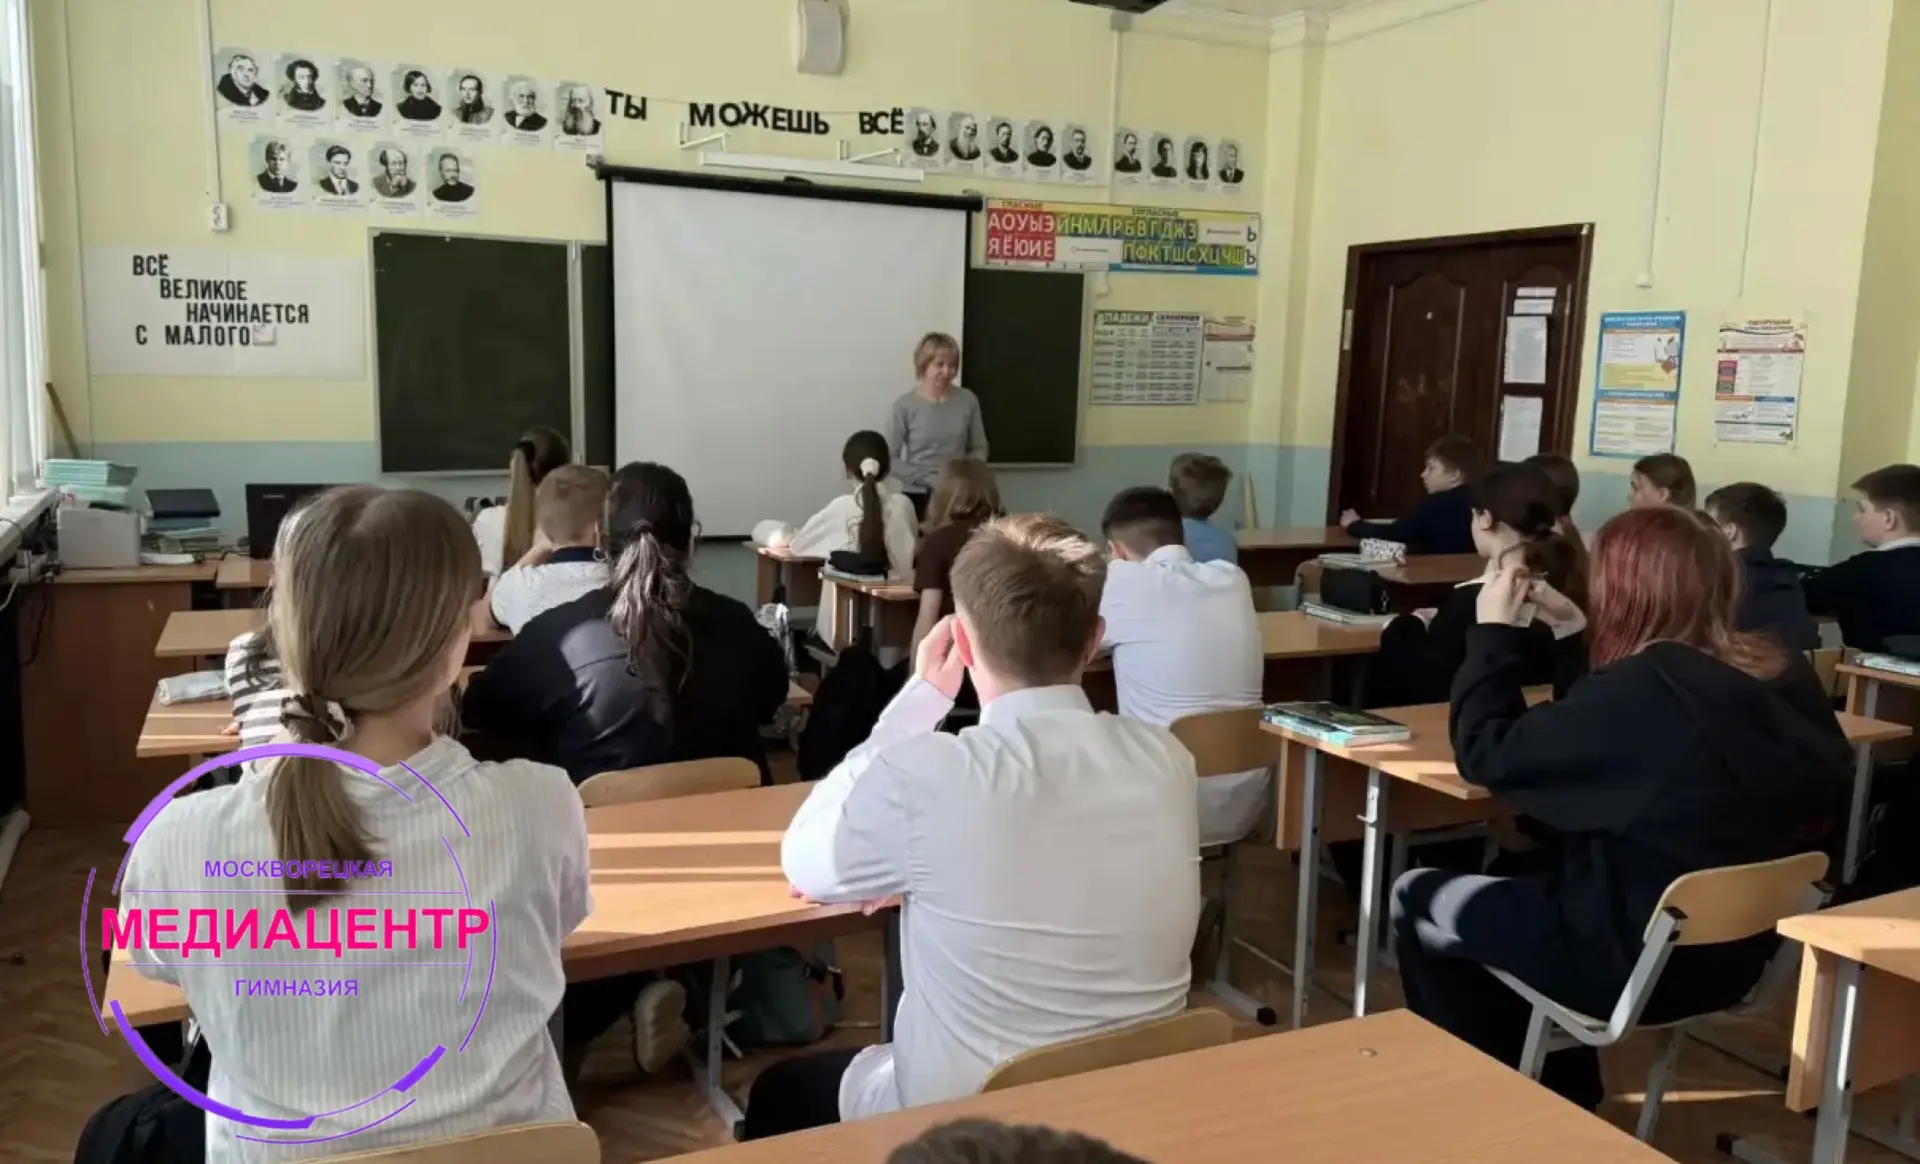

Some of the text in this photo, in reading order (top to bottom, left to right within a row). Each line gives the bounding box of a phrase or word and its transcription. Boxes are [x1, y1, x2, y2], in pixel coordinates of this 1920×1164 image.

[605, 88, 905, 135] ТЫ МОЖЕШЬ ВСЁ
[132, 254, 169, 276] ВСЁ
[160, 278, 248, 300] ВЕЛИКОЕ
[186, 302, 310, 324] НАЧИНАЕТСЯ
[135, 324, 250, 345] С МАЛОГО
